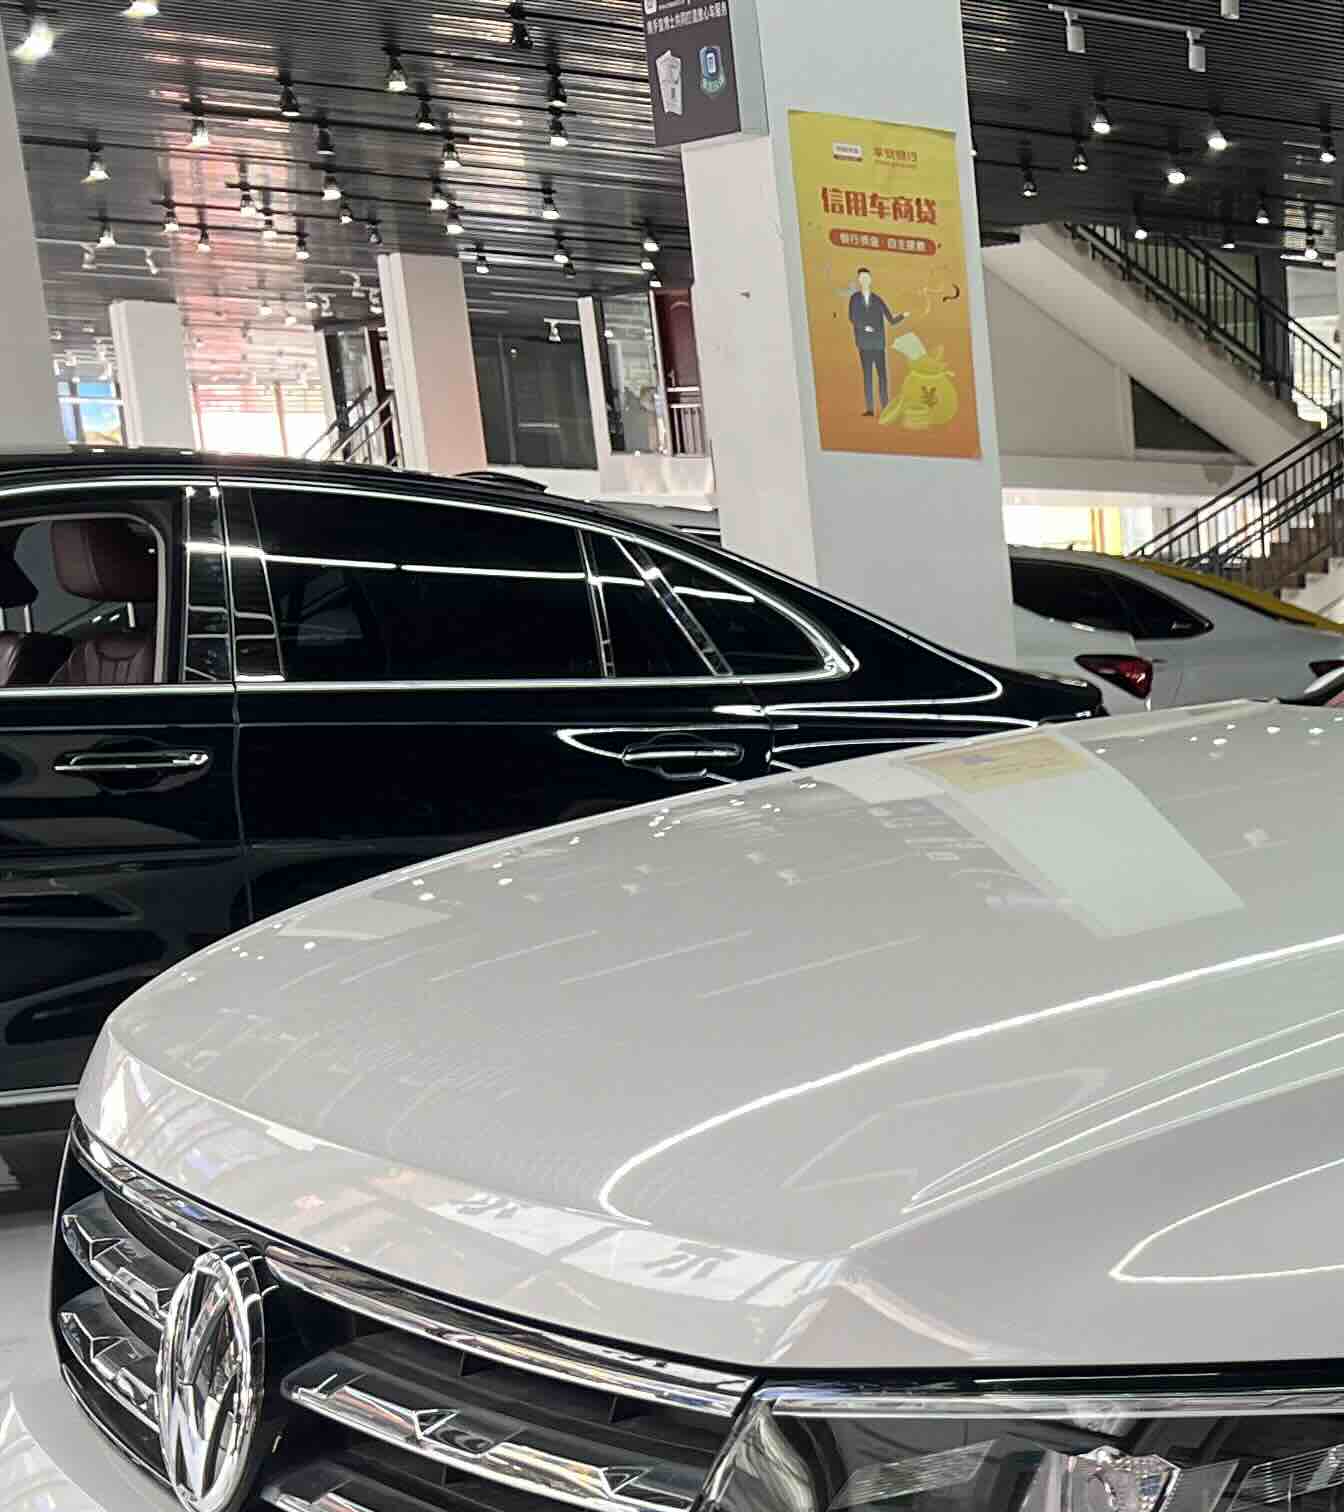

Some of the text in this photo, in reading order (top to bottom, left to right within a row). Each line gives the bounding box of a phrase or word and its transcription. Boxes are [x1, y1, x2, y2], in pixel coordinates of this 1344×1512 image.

[821, 186, 937, 225] 信用车商贷
